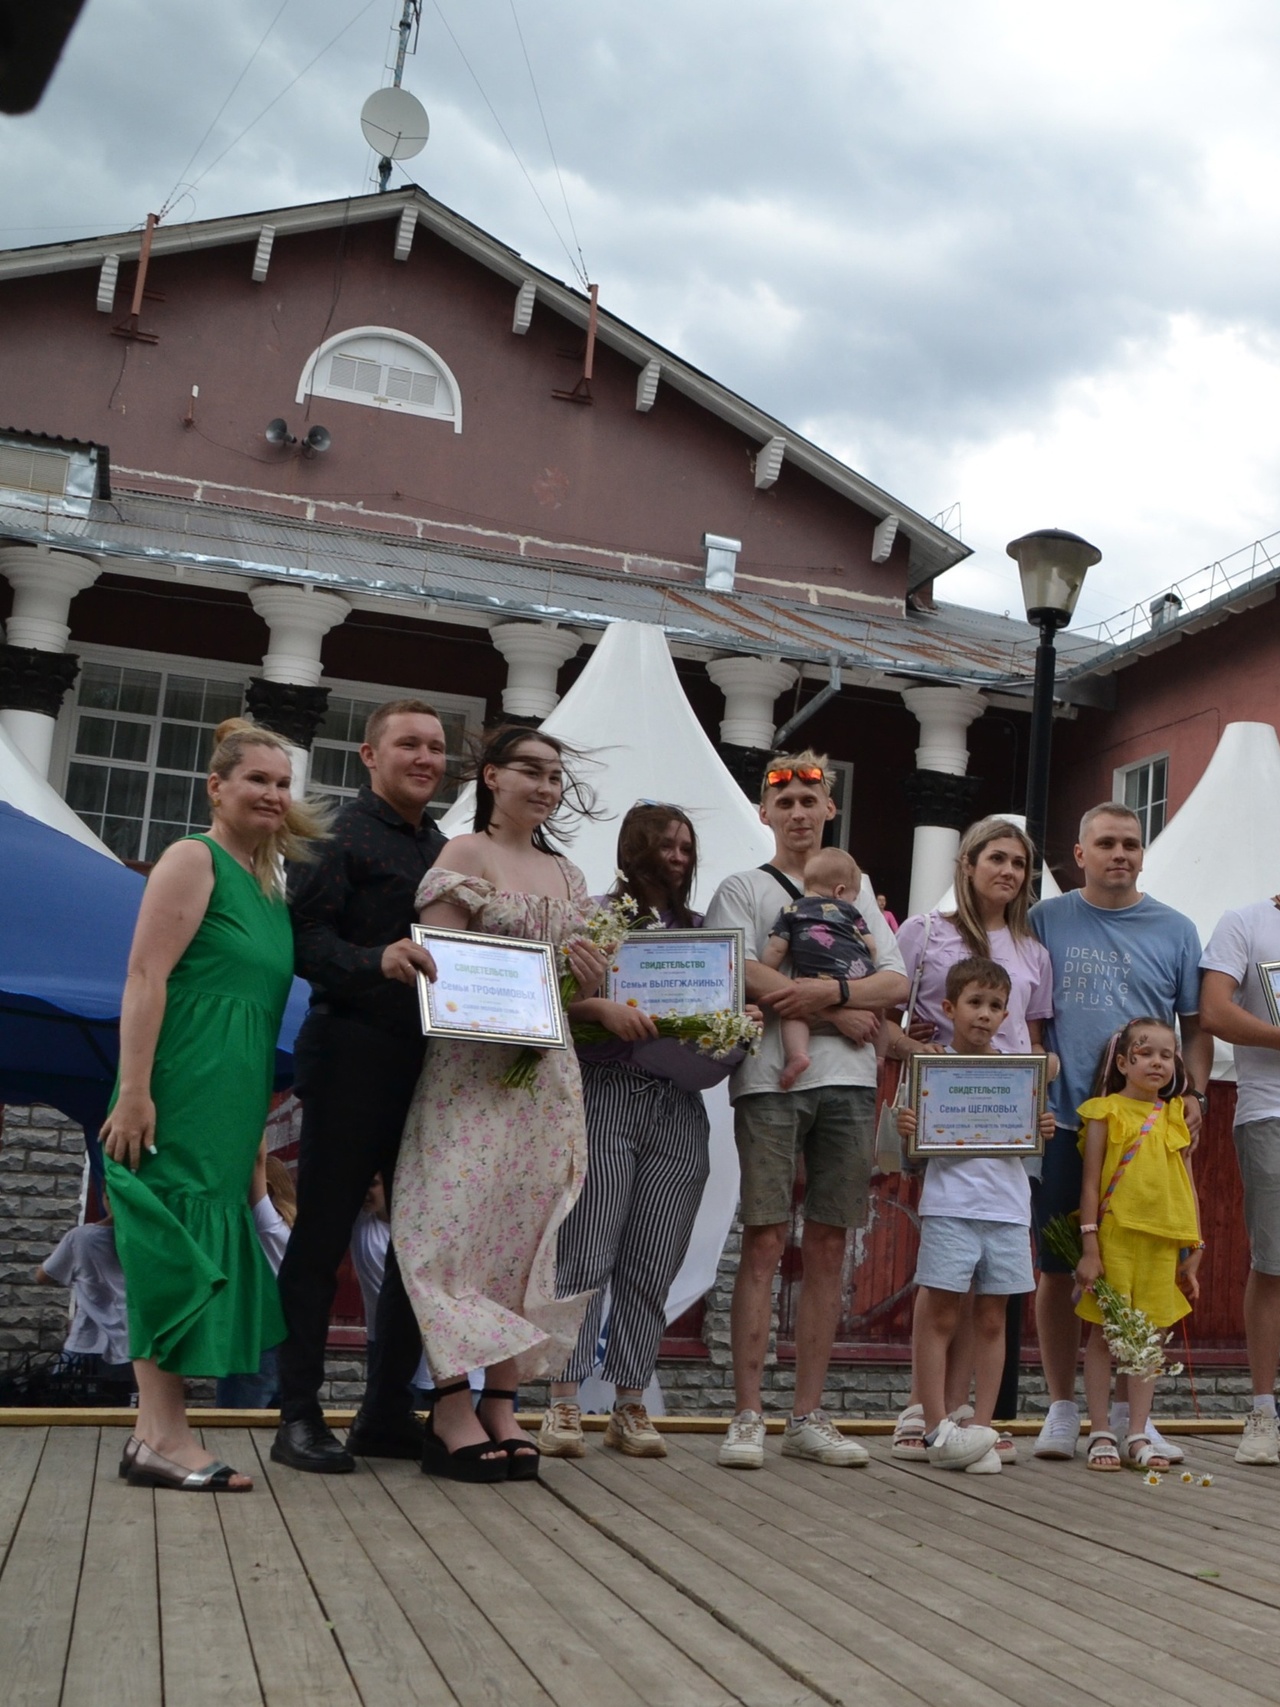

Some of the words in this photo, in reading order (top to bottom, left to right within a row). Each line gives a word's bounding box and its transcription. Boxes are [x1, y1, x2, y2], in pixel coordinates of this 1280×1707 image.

[1065, 946, 1118, 963] IDEALS
[1123, 952, 1131, 965] &
[454, 963, 519, 979] СВИДЕТЕЛЬСТВО
[640, 960, 705, 970] СВИДЕТЕЛЬСТВО
[1064, 961, 1131, 979] DIGNITY
[441, 981, 470, 992] Семьи
[471, 984, 536, 1000] ТРОФИМОВЫХ
[621, 980, 648, 989] Семьи
[649, 979, 725, 989] ВЫЛЕГЖАНИНЫХ
[1063, 976, 1128, 994] BRING
[1063, 991, 1128, 1008] TRUST
[948, 1086, 1011, 1095] СВИДЕТЕЛЬСТВО
[939, 1104, 966, 1114] Семьи
[968, 1104, 1018, 1114] ЩЕЛКОВЫХ
